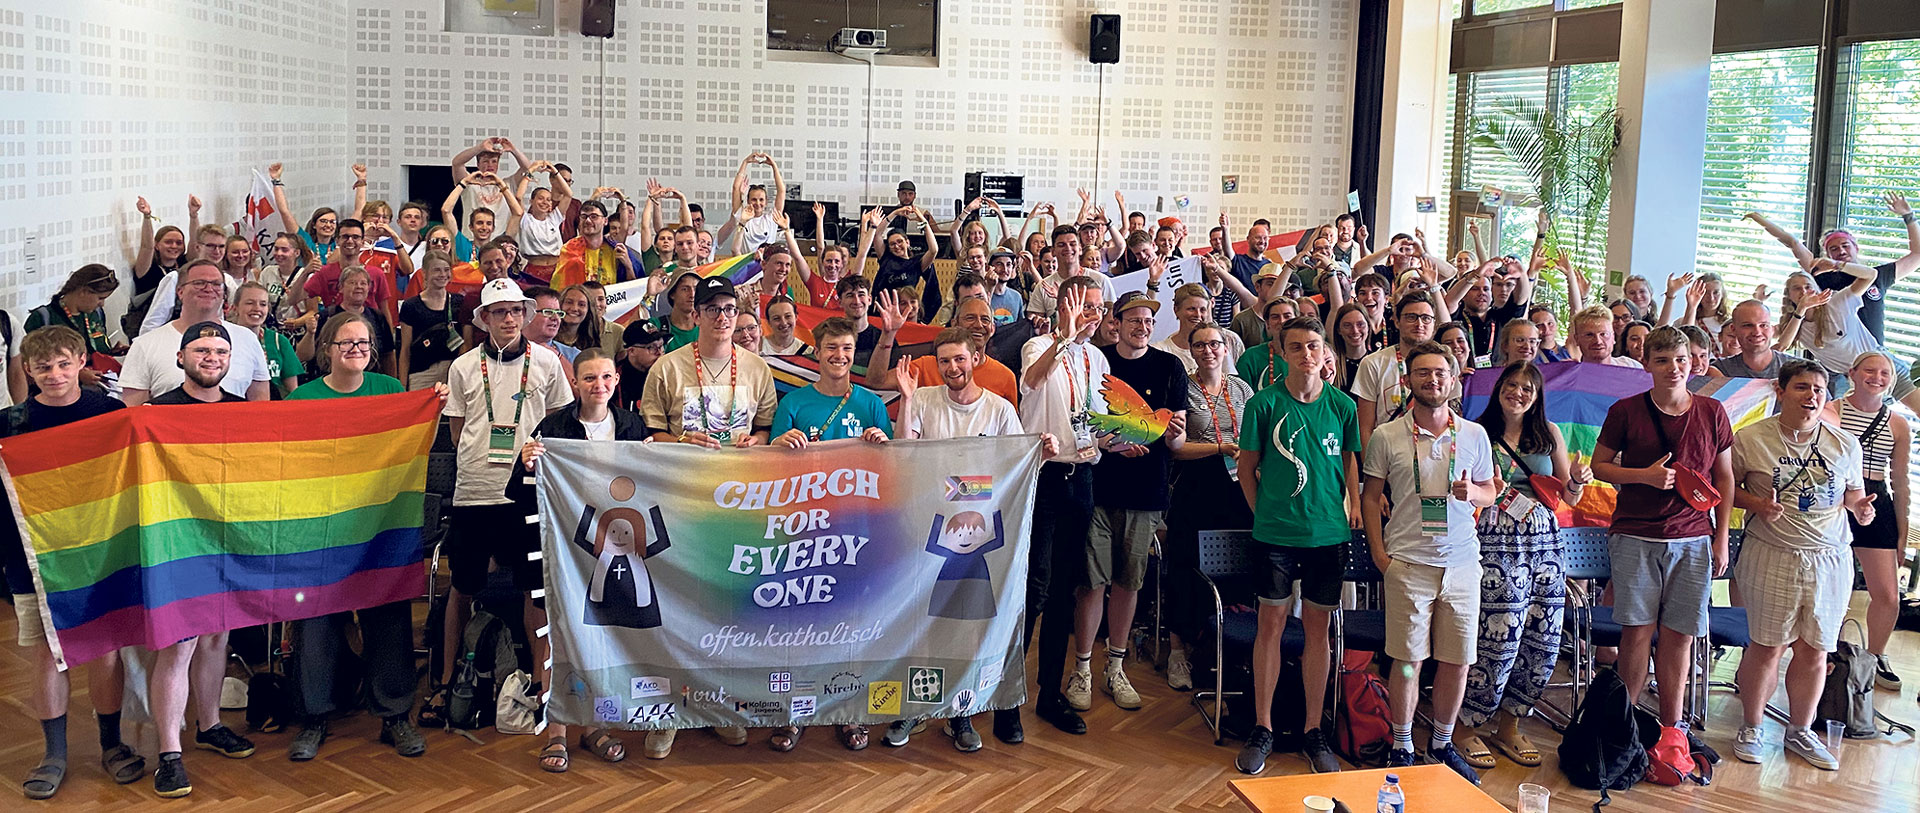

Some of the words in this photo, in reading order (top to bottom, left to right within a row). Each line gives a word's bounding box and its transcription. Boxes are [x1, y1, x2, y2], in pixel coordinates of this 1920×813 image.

[605, 290, 627, 305] ERLIN
[713, 468, 881, 510] CHURCH
[763, 508, 831, 540] FOR
[727, 534, 869, 576] EVERY
[753, 574, 837, 608] ONE
[699, 618, 884, 658] offen.katholisch
[643, 682, 658, 690] AKD
[823, 683, 865, 695] Kirche
[871, 686, 898, 711] Kirche
